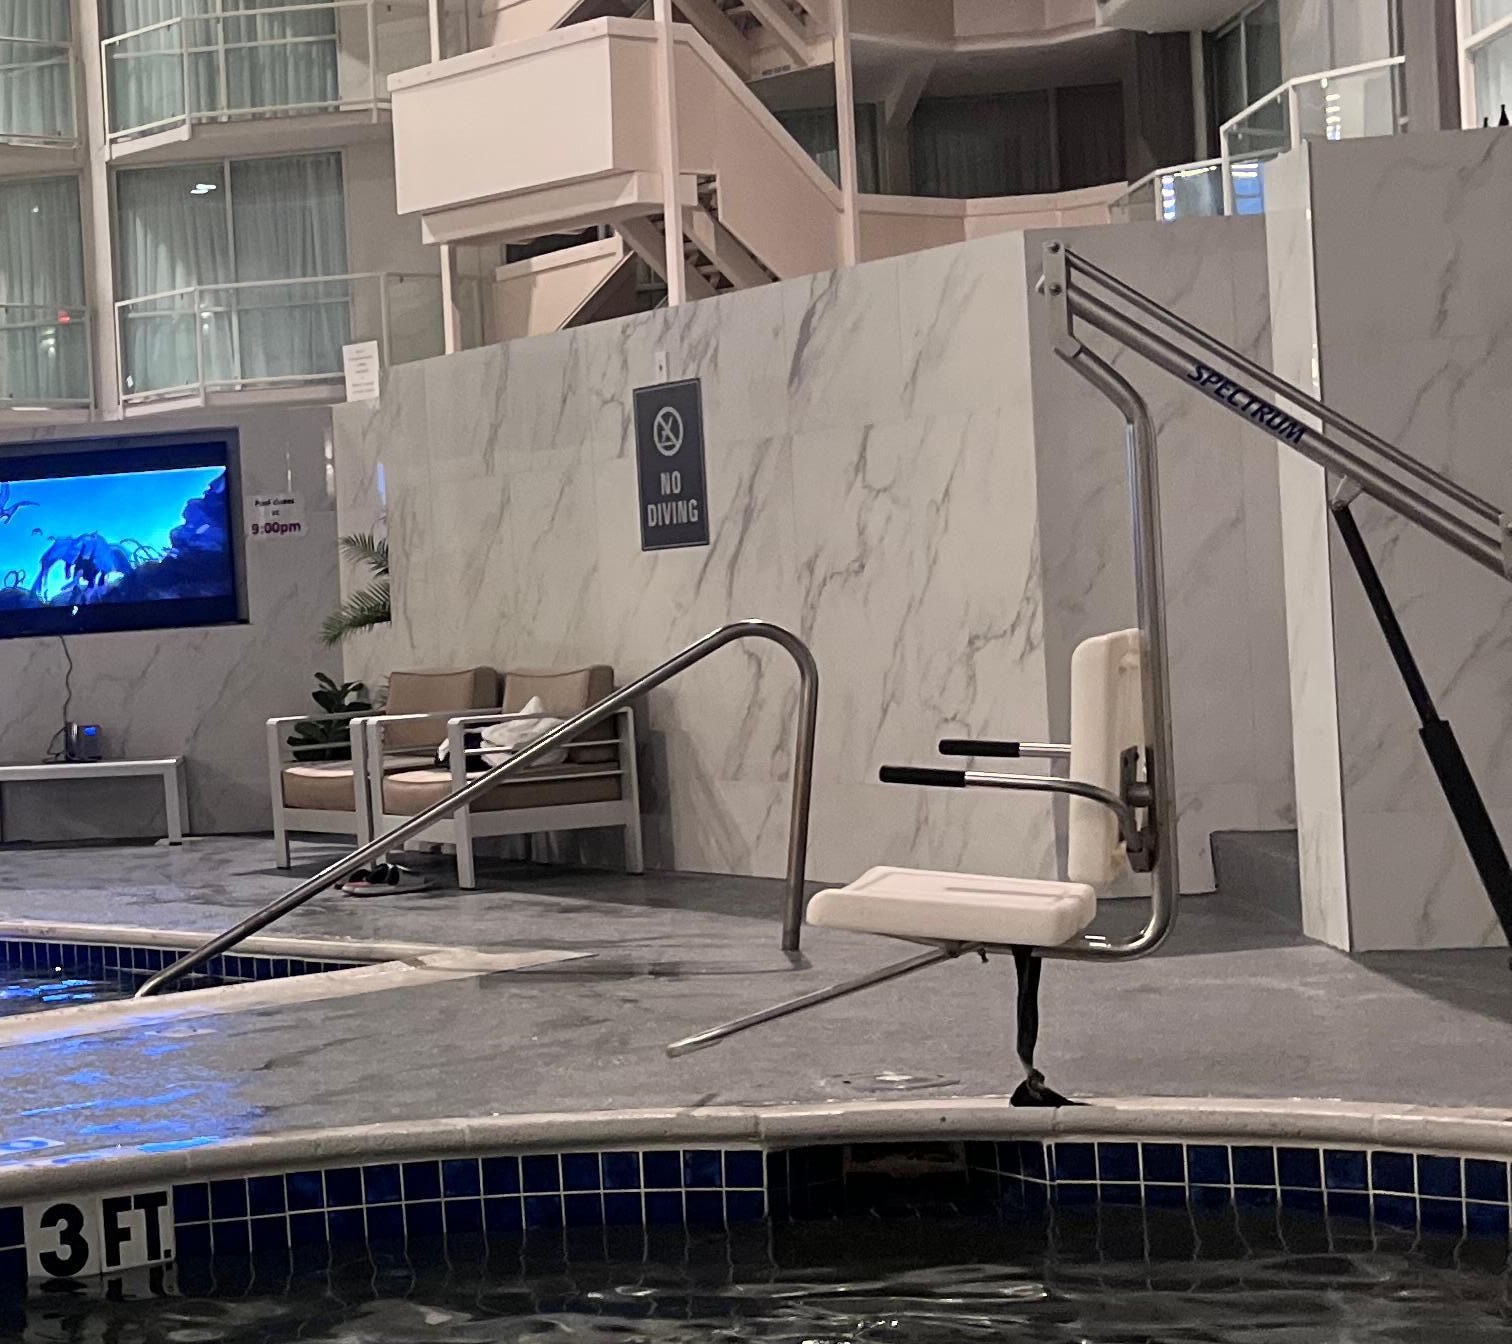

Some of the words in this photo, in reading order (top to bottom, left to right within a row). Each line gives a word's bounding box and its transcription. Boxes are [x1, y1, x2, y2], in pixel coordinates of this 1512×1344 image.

[1186, 363, 1307, 445] SPECTRUM
[660, 470, 681, 495] NO
[251, 521, 302, 535] 9:00pm
[647, 499, 699, 528] DIVING
[39, 1202, 90, 1277] 3
